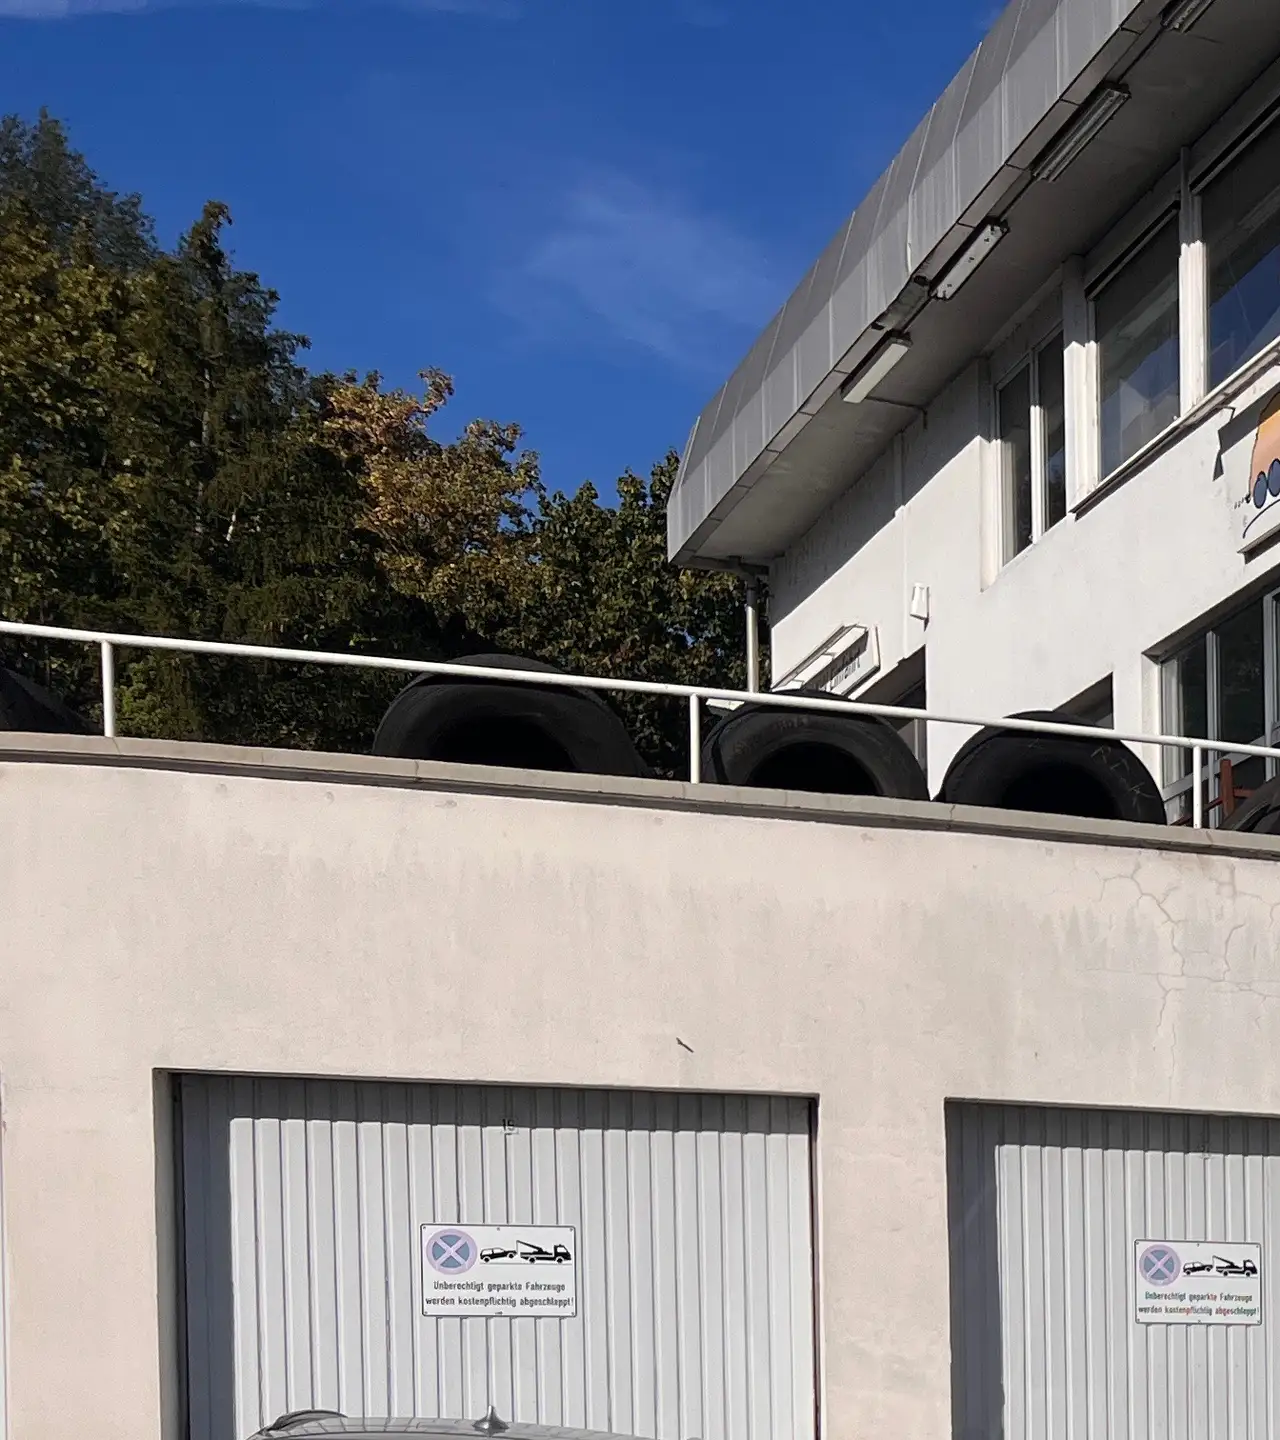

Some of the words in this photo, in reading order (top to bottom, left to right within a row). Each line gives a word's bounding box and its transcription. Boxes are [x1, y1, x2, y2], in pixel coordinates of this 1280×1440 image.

[433, 1281, 484, 1292] Unberechtigt
[488, 1282, 522, 1292] geparkte
[525, 1281, 565, 1293] Fahrzeuge
[425, 1297, 455, 1305] werden
[458, 1297, 516, 1307] kostenpflichtig
